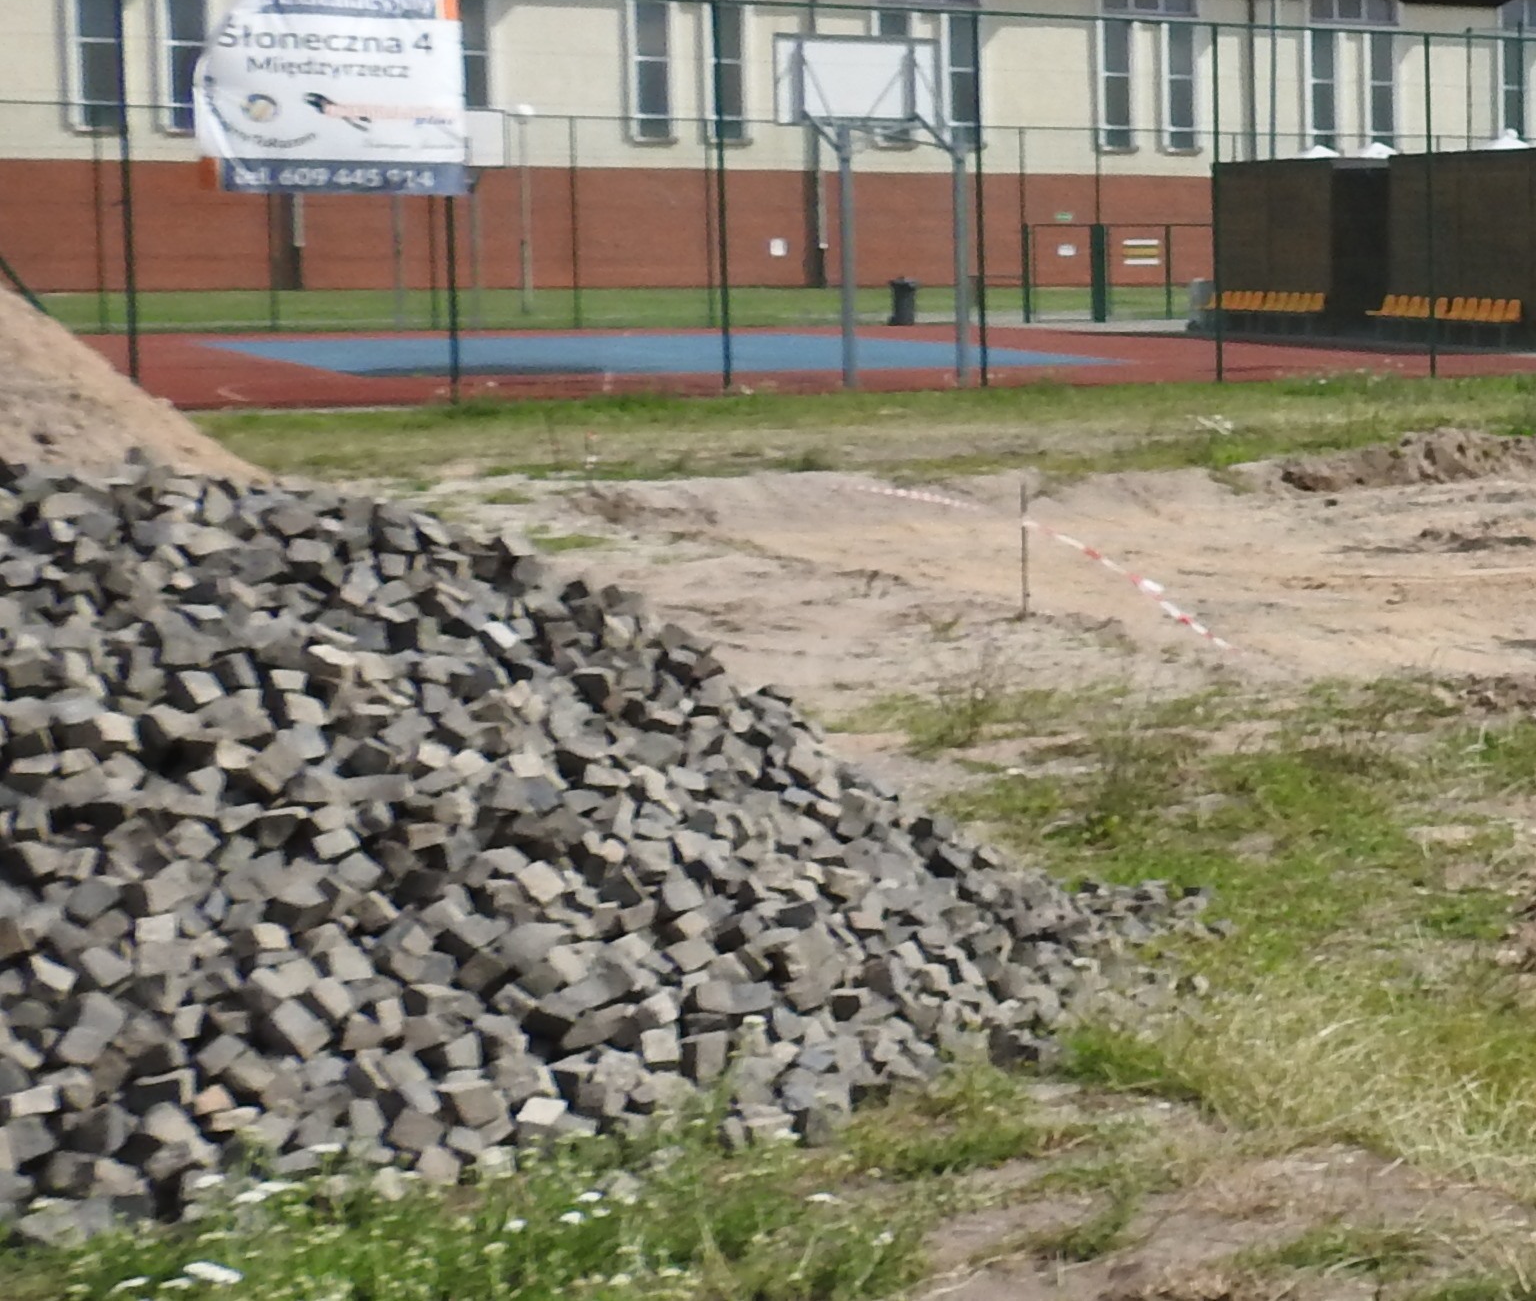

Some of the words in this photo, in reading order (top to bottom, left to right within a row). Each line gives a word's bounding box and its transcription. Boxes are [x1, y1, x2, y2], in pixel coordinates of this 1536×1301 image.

[217, 16, 403, 55] Słoneczna
[412, 31, 434, 54] 4
[247, 56, 410, 79] Międzyrzecz
[278, 166, 331, 187] 609
[333, 168, 384, 188] 445
